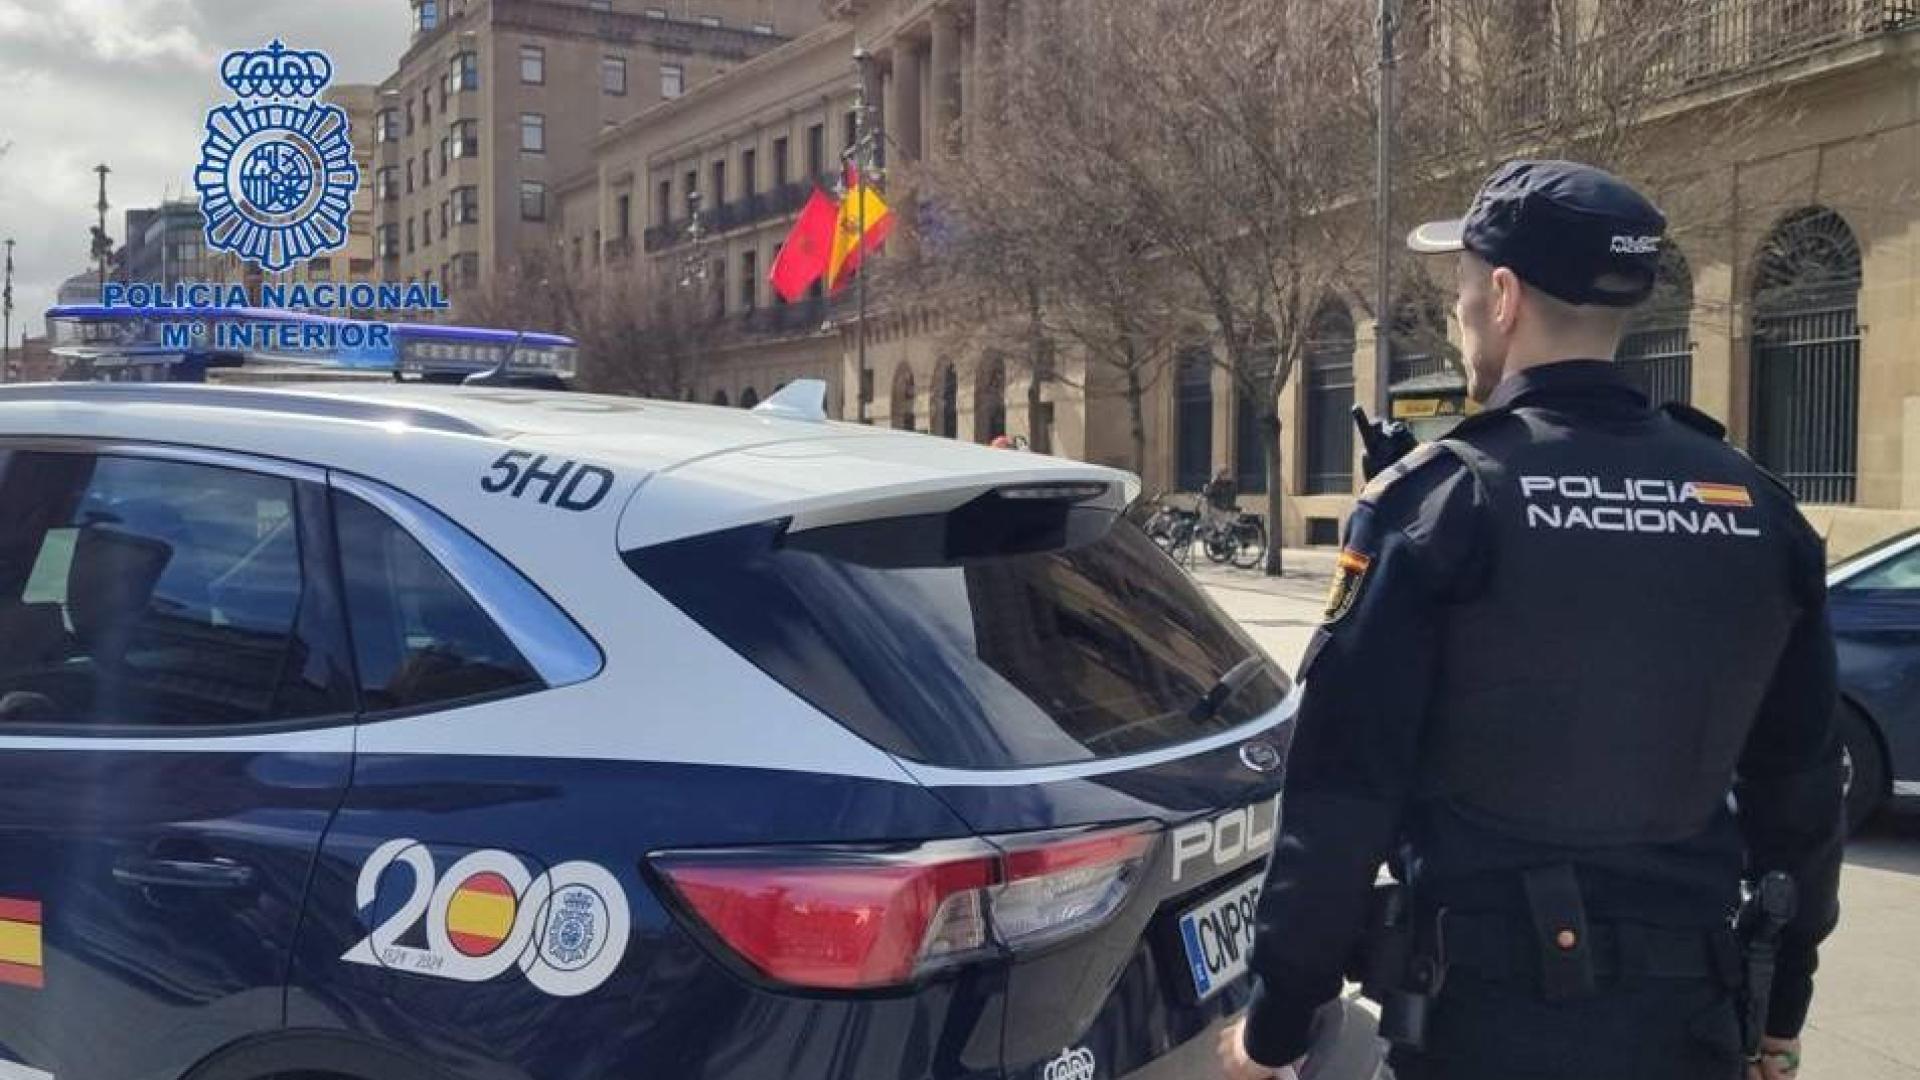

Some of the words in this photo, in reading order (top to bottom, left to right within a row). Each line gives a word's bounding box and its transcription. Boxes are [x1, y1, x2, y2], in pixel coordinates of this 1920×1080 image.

[480, 449, 615, 512] 5HD
[1519, 475, 1704, 503] POLICIA
[1526, 503, 1761, 537] NACIONAL
[341, 838, 630, 997] 200
